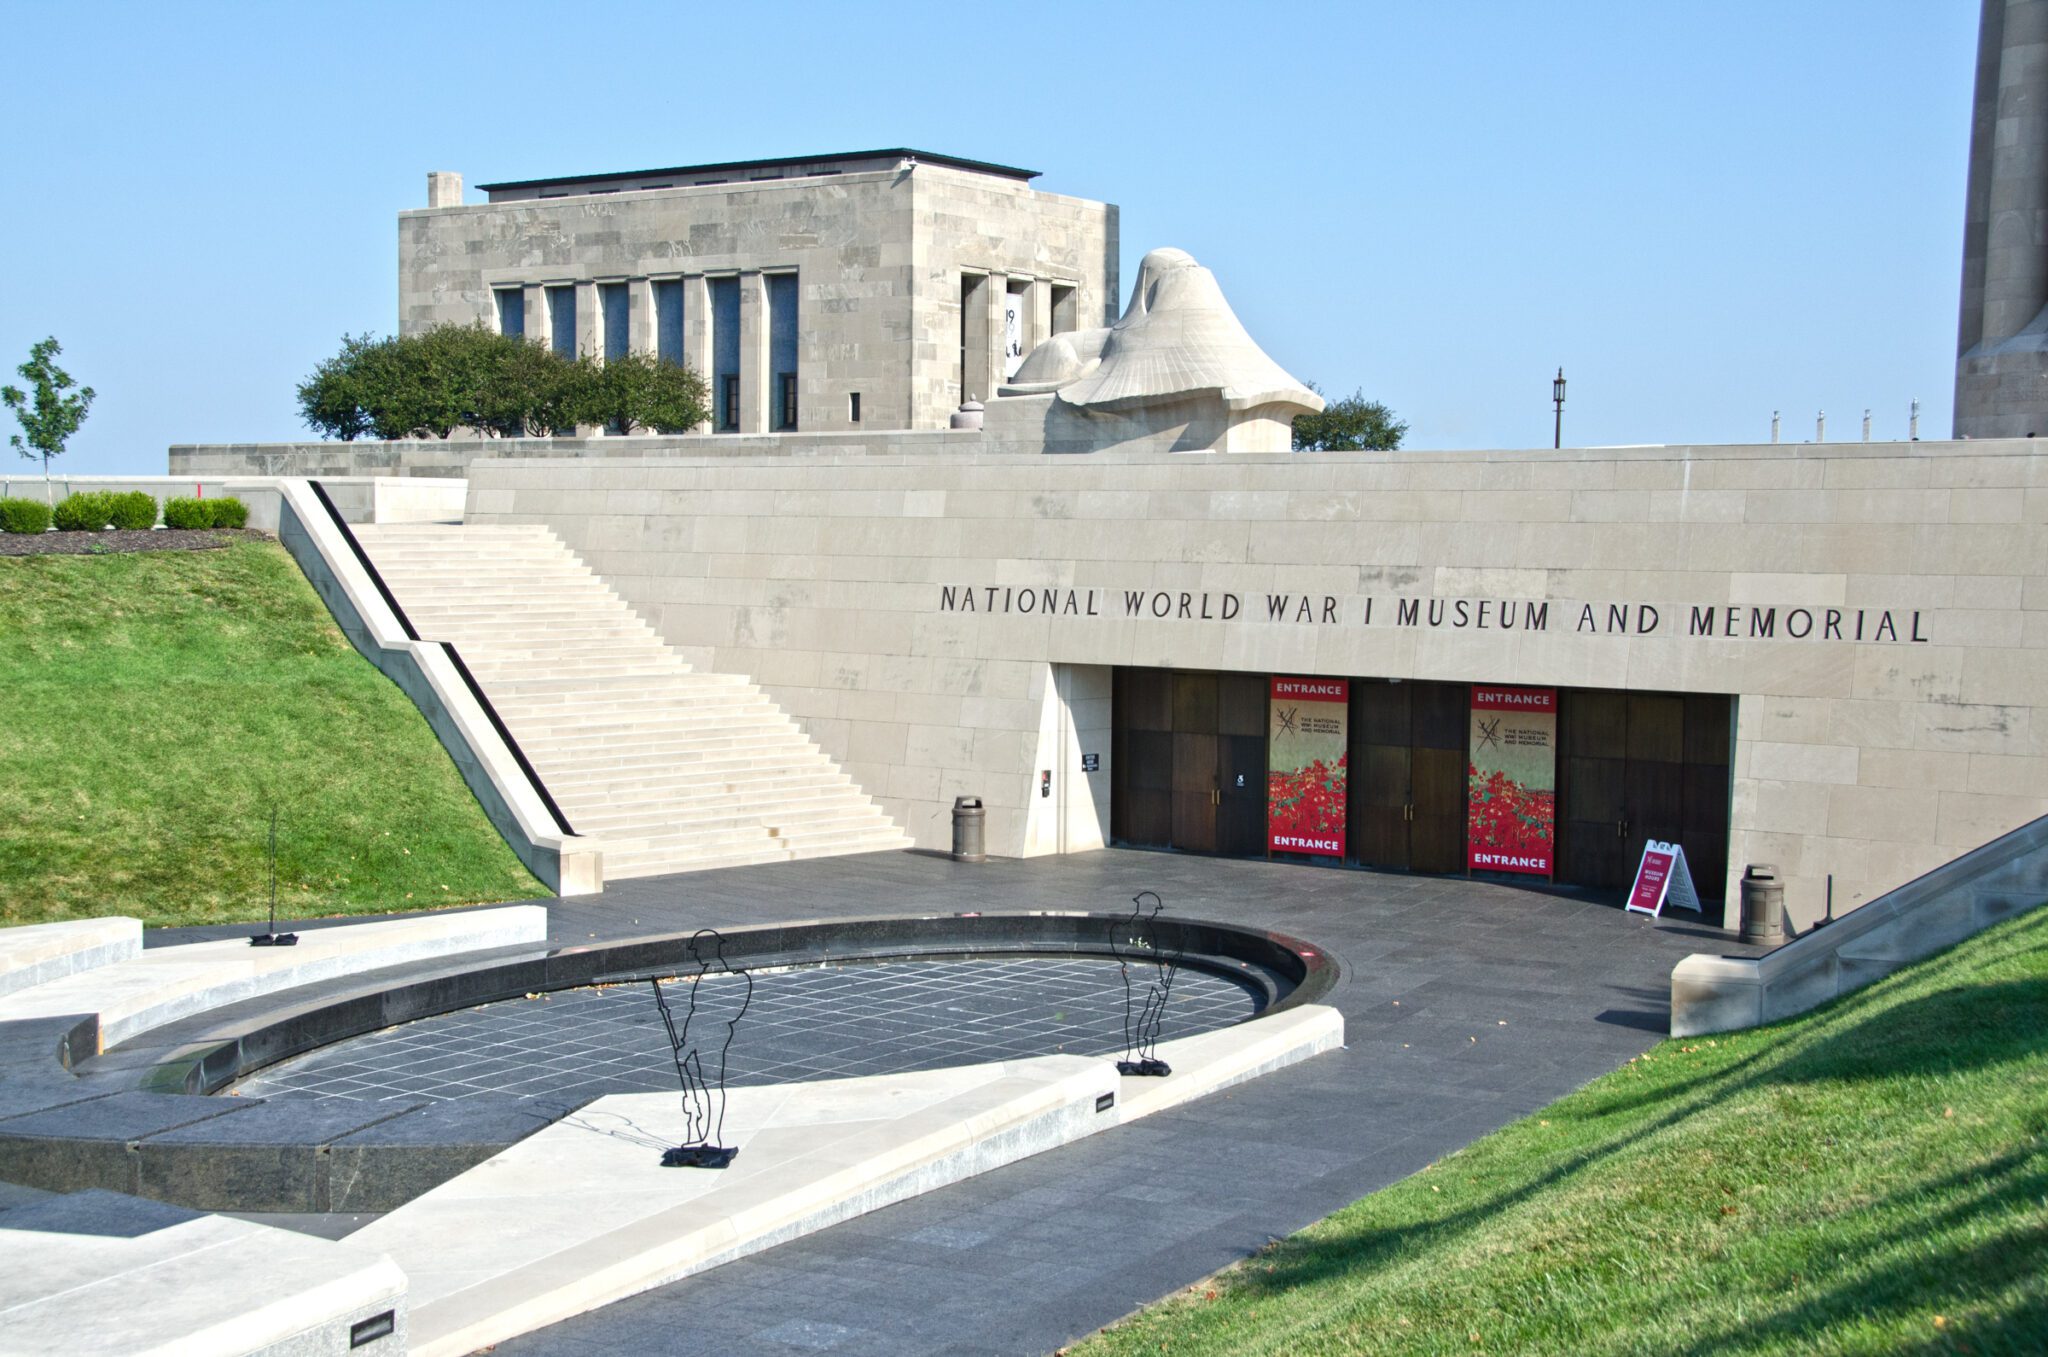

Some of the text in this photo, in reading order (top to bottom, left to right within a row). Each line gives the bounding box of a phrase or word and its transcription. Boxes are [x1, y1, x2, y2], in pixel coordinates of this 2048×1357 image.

[940, 585, 1929, 643] NATIONAL WORLD WAR I MUSEUM AND MEMORIAL
[1276, 683, 1342, 695] ENTRANCE
[1477, 692, 1550, 705] ENTRANCE
[1274, 836, 1339, 850] ENTRANCE
[1474, 853, 1546, 868] ENTRANCE
